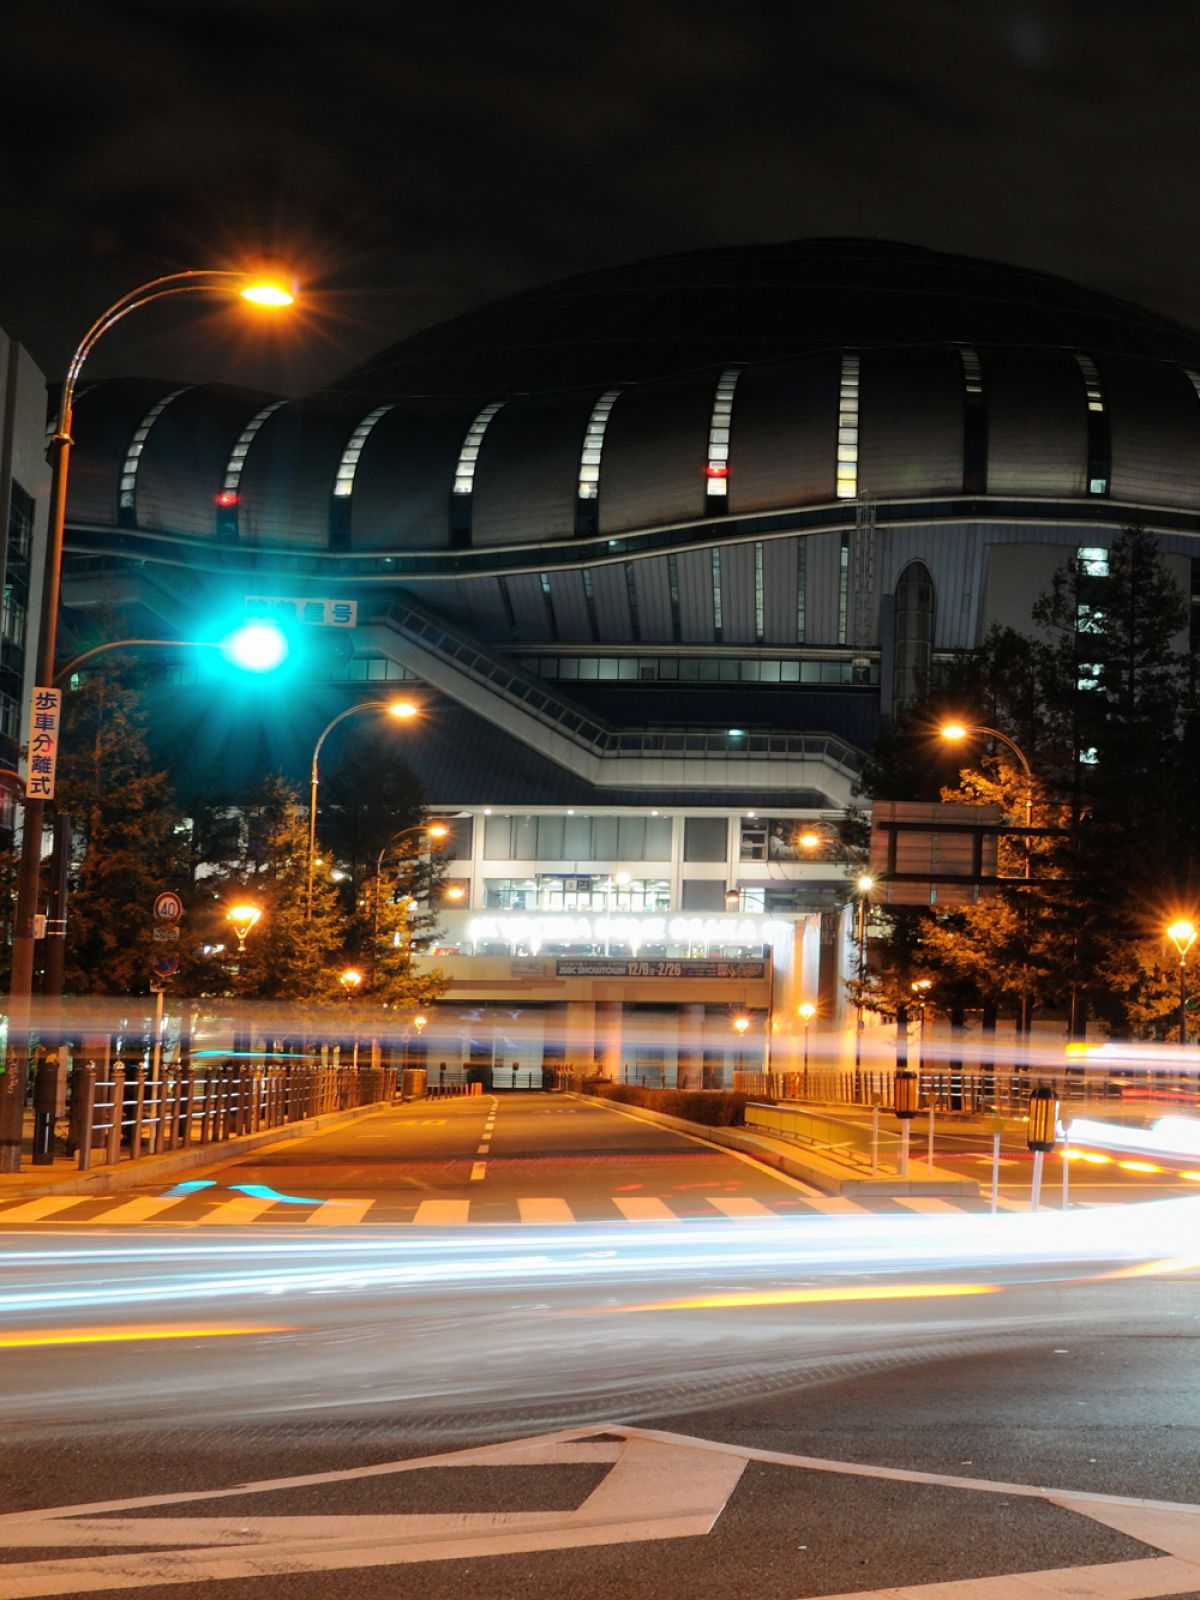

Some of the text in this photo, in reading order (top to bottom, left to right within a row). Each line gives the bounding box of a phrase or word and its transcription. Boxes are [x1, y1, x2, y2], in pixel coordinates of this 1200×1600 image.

[30, 691, 57, 796] 歩車分離式
[160, 902, 176, 916] 40
[628, 962, 649, 976] 12/9
[657, 962, 682, 976] 2/26
